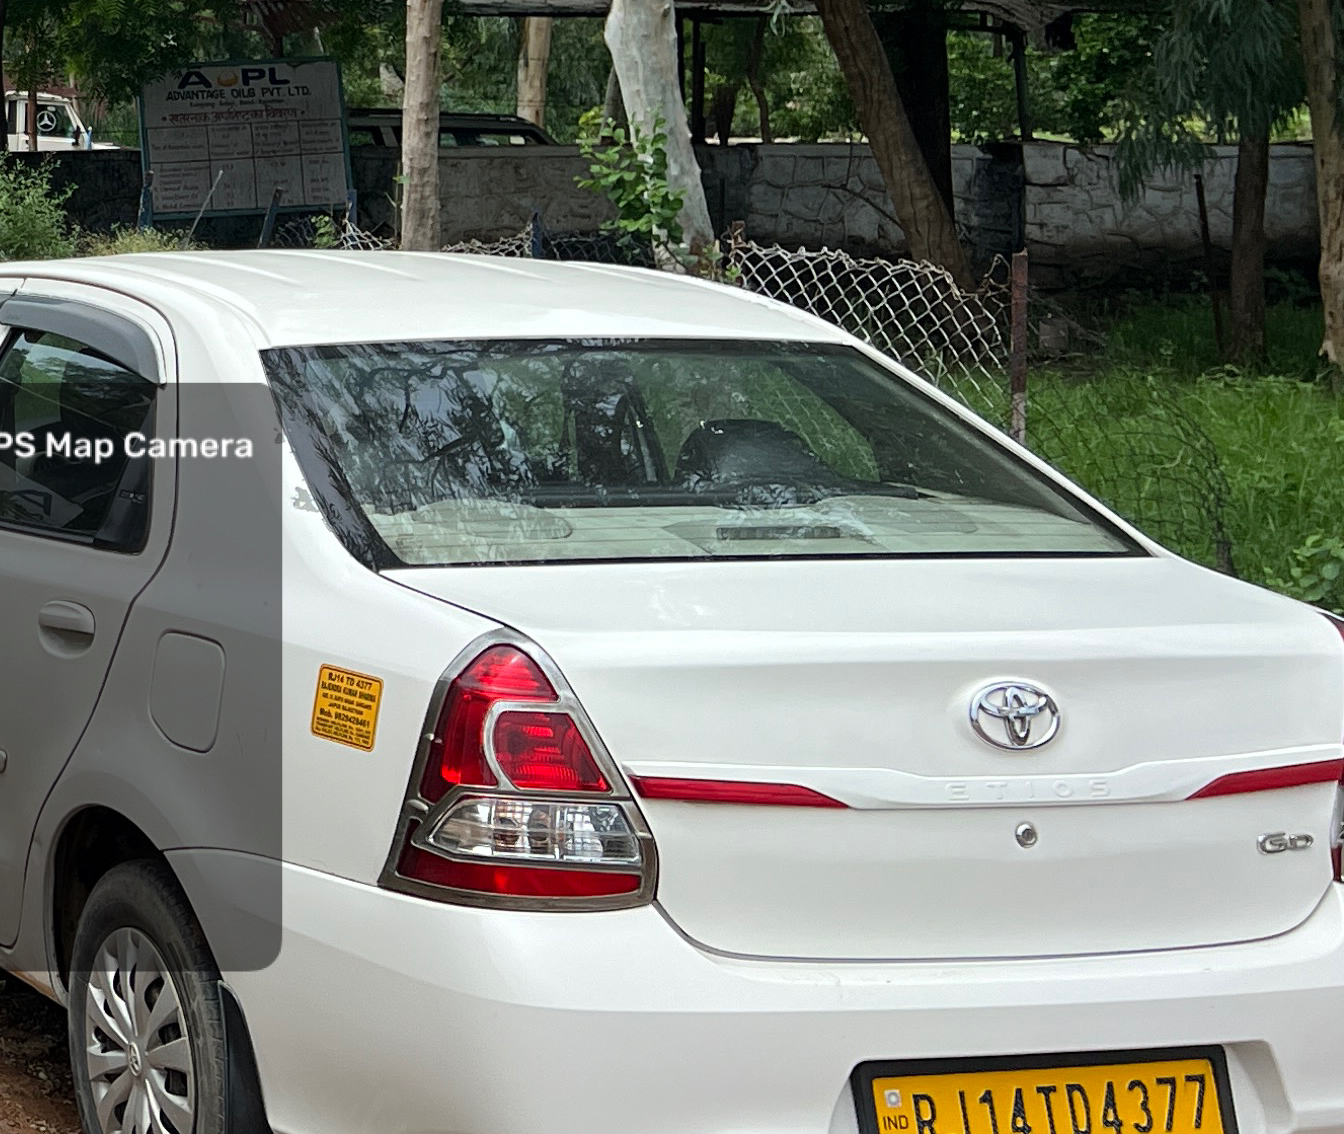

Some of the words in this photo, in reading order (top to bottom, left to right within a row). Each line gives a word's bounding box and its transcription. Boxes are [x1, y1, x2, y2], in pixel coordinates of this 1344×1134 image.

[178, 70, 213, 89] A
[166, 89, 226, 101] ADVANTAGE
[944, 778, 1112, 802] ETIOS
[1255, 831, 1315, 856] GD
[913, 1072, 1207, 1134] RJ14TD4377
[882, 1114, 909, 1131] IND
